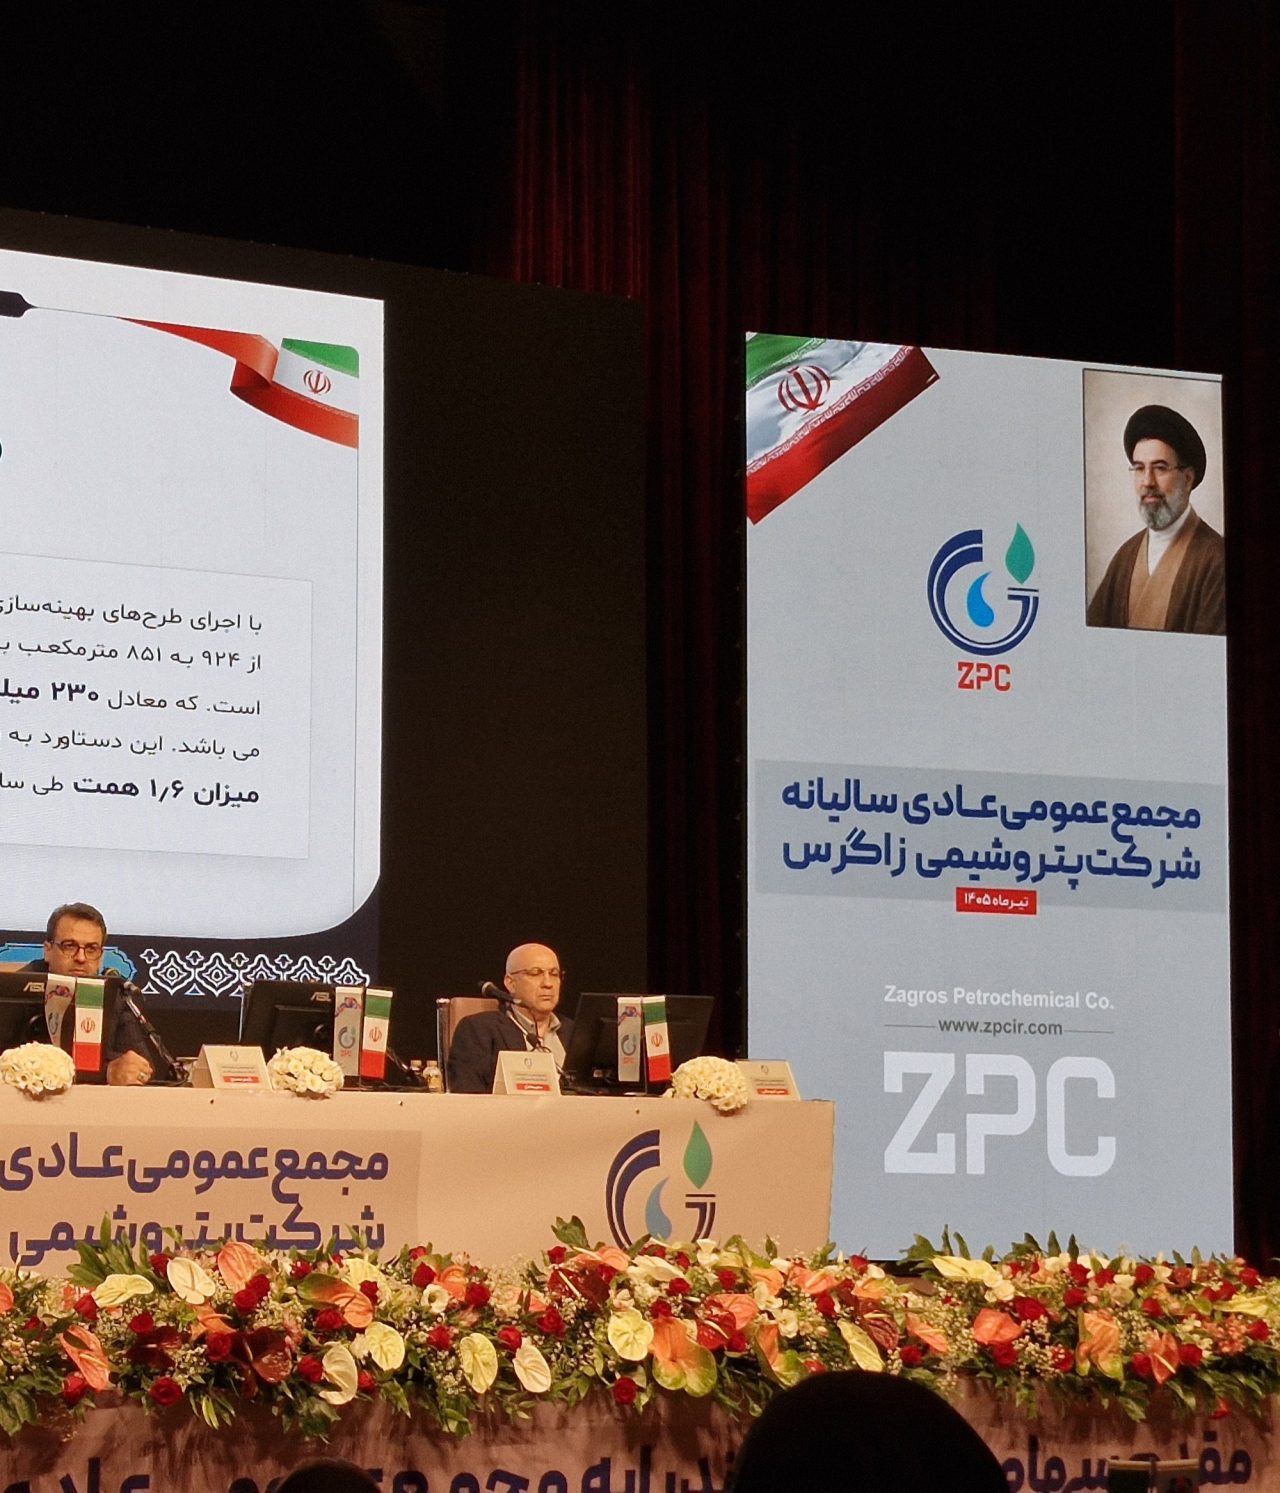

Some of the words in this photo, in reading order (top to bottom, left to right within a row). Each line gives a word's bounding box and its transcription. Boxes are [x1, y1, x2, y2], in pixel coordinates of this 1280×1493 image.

[189, 610, 241, 633] اجرای
[249, 614, 263, 636] با
[17, 639, 119, 662] مترمکعب
[126, 644, 162, 662] ۸۵۱
[169, 652, 194, 668] به
[201, 650, 240, 668] ۹۲۴
[246, 654, 261, 674] از
[957, 661, 1011, 692] ZPC
[50, 681, 100, 702] ۲۳۰
[107, 690, 168, 711] معادل
[175, 695, 199, 711] که
[8, 730, 33, 747] به
[40, 729, 123, 750] دستاورد
[129, 735, 163, 756] این
[232, 747, 260, 762] می
[32, 775, 64, 796] طی
[73, 777, 140, 797] همت
[193, 781, 260, 809] میزان
[781, 776, 898, 823] سالیانه
[902, 784, 999, 825] عادی
[1000, 798, 1109, 832] عمومی
[1110, 800, 1201, 843] مجمع
[782, 826, 907, 877] زاگرس
[915, 836, 1085, 890] پتروشیمی
[1086, 843, 1201, 889] شرکت
[964, 892, 991, 905] ۱۴۰۵
[884, 985, 949, 1006] Zagros
[953, 986, 1081, 1009] Petrochemical
[1085, 990, 1115, 1010] Co.
[938, 1018, 1063, 1038] www.zpcir.com
[883, 1050, 1117, 1177] ZPC
[127, 1147, 269, 1195] عمومی
[271, 1149, 389, 1204] مجمع
